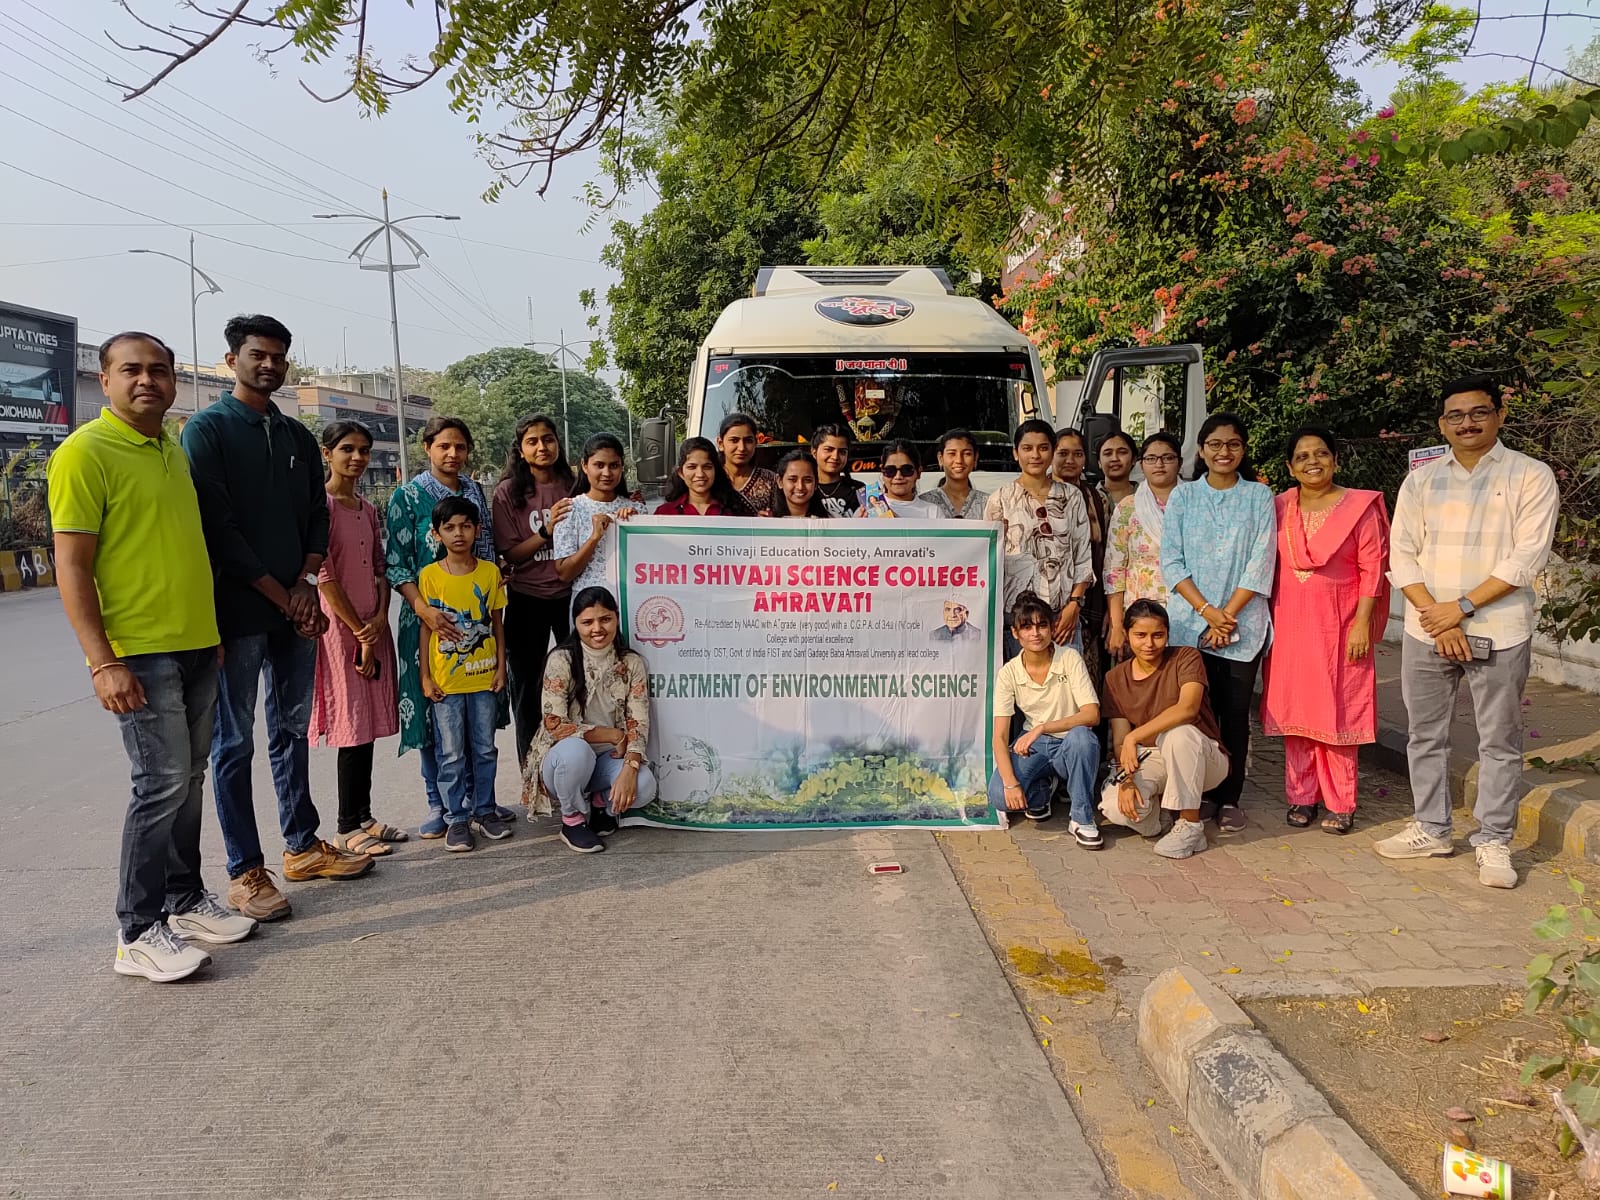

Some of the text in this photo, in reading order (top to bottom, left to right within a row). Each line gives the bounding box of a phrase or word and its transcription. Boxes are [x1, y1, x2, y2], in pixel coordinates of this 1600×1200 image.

[0, 325, 58, 347] UPTA TYRES
[0, 405, 44, 420] OKOHAMA
[688, 544, 936, 560] Shri Shivaji Education Society, Amravati's
[20, 553, 47, 580] A B
[634, 563, 986, 588] SHRI SHIVAJI SCIENCE COLLEGE,
[754, 592, 872, 612] AMRAVATI
[734, 618, 741, 631] by
[743, 618, 759, 629] NAAC
[761, 619, 772, 629] with
[780, 620, 796, 631] grade
[831, 620, 842, 629] with
[875, 620, 880, 629] of
[766, 634, 854, 645] College with potential excellence
[704, 648, 710, 660] by
[746, 648, 752, 657] of
[753, 648, 766, 657] India
[767, 648, 780, 658] FIST
[782, 648, 792, 658] and
[794, 648, 806, 658] Sant
[830, 648, 844, 658] Baba
[846, 648, 869, 658] Amravati
[871, 649, 896, 660] University
[907, 649, 918, 658] lead
[920, 649, 939, 660] college
[648, 674, 978, 698] EPARTMENT OF ENVIRONMENTAL SCIENCE
